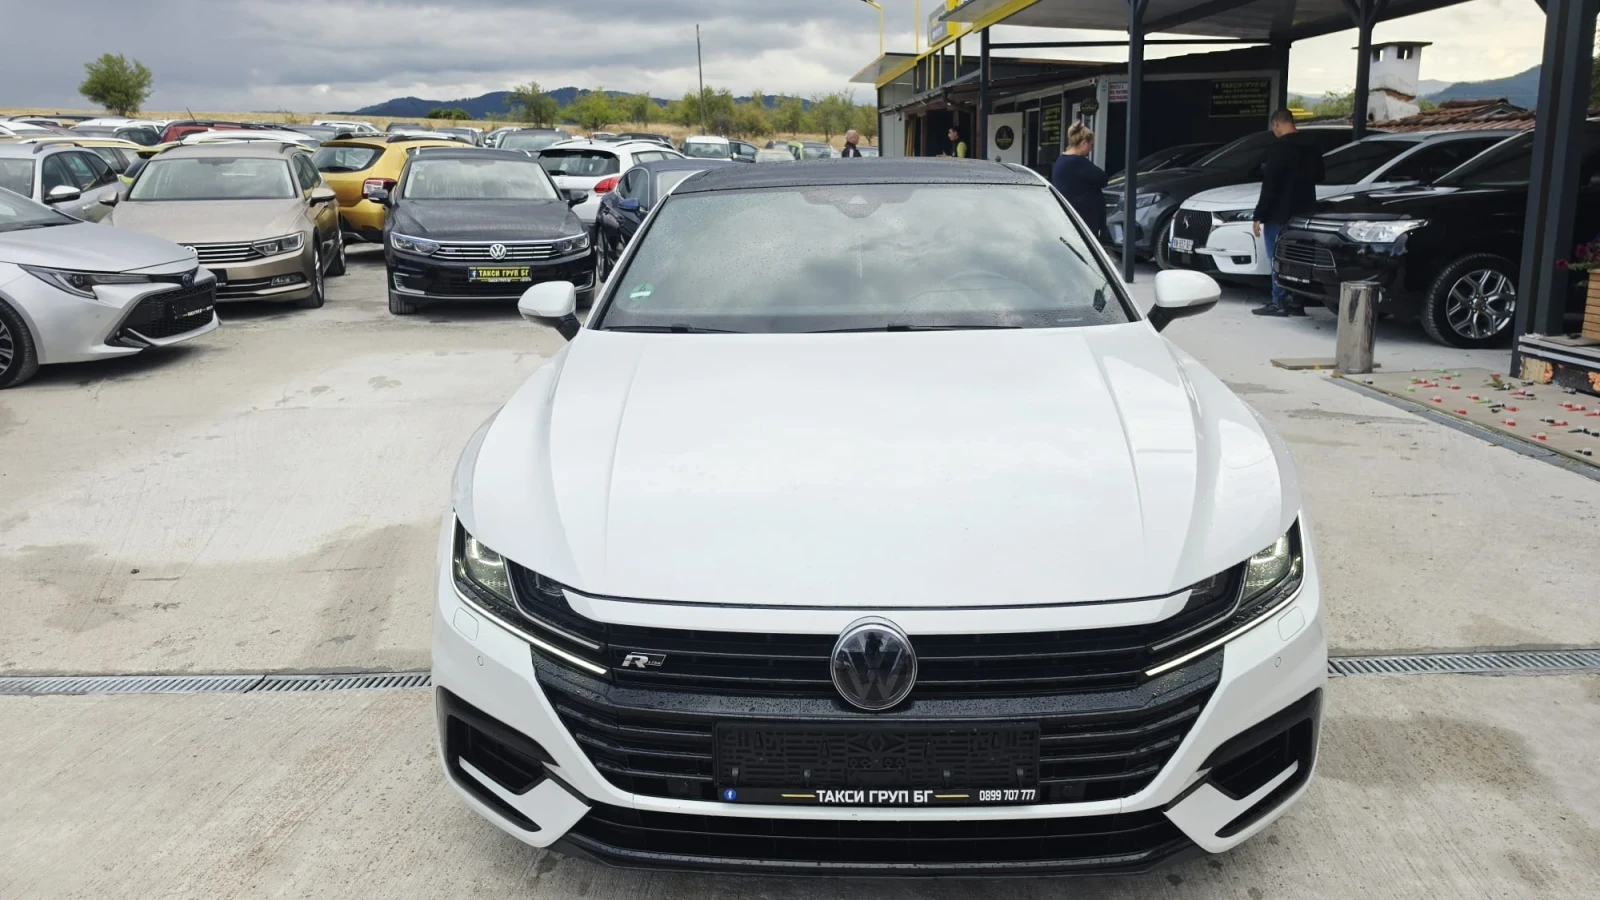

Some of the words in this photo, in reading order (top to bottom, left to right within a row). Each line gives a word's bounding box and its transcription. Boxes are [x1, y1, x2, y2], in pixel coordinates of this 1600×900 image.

[622, 654, 648, 668] R
[816, 790, 864, 803] ТАКСИ
[869, 790, 909, 803] ГРУП
[913, 790, 933, 803] БГ
[979, 789, 1001, 801] 0899
[1003, 789, 1019, 801] 707
[1020, 789, 1036, 800] 777
